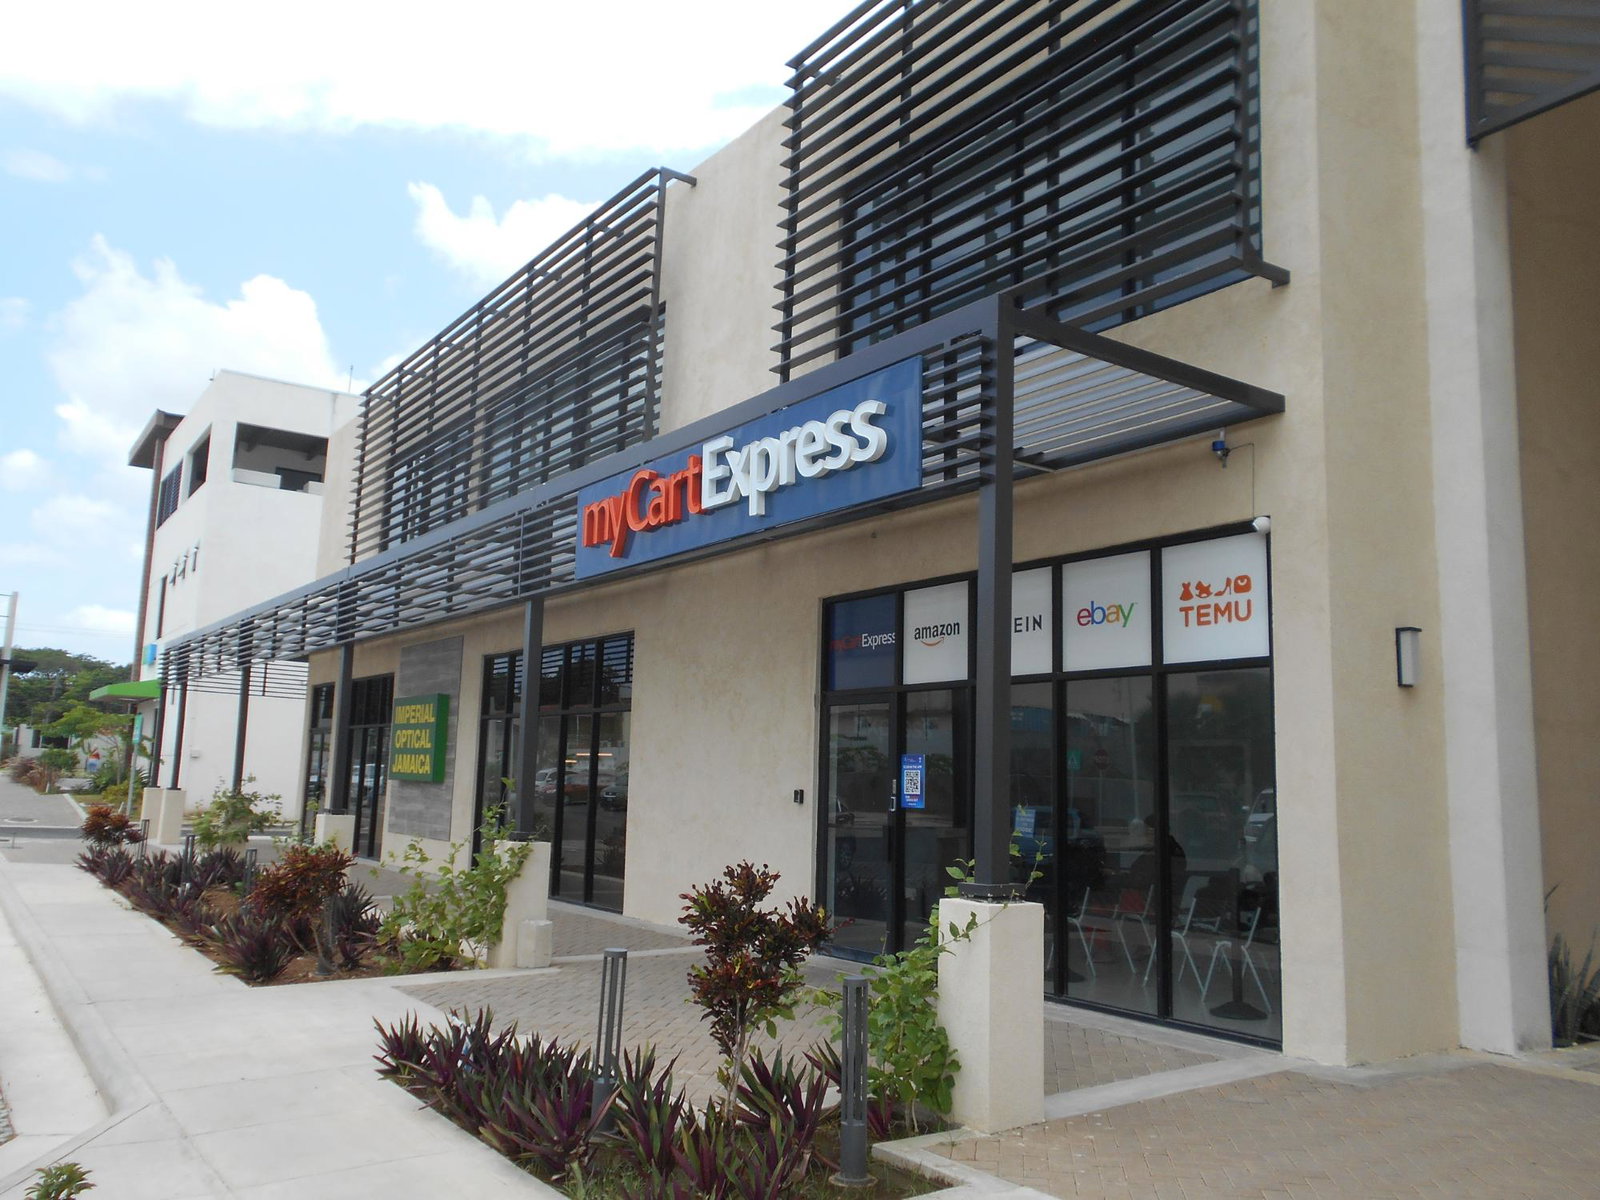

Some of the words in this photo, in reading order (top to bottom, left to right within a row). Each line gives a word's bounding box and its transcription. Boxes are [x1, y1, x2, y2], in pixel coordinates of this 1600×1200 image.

[1077, 600, 1135, 628] ebay
[1179, 598, 1252, 627] TEMU
[914, 622, 960, 640] amazon
[1014, 614, 1042, 633] EIN
[395, 704, 435, 724] IMPERIAL
[395, 729, 432, 748] OPTICAL
[392, 754, 430, 774] JAMAICA
